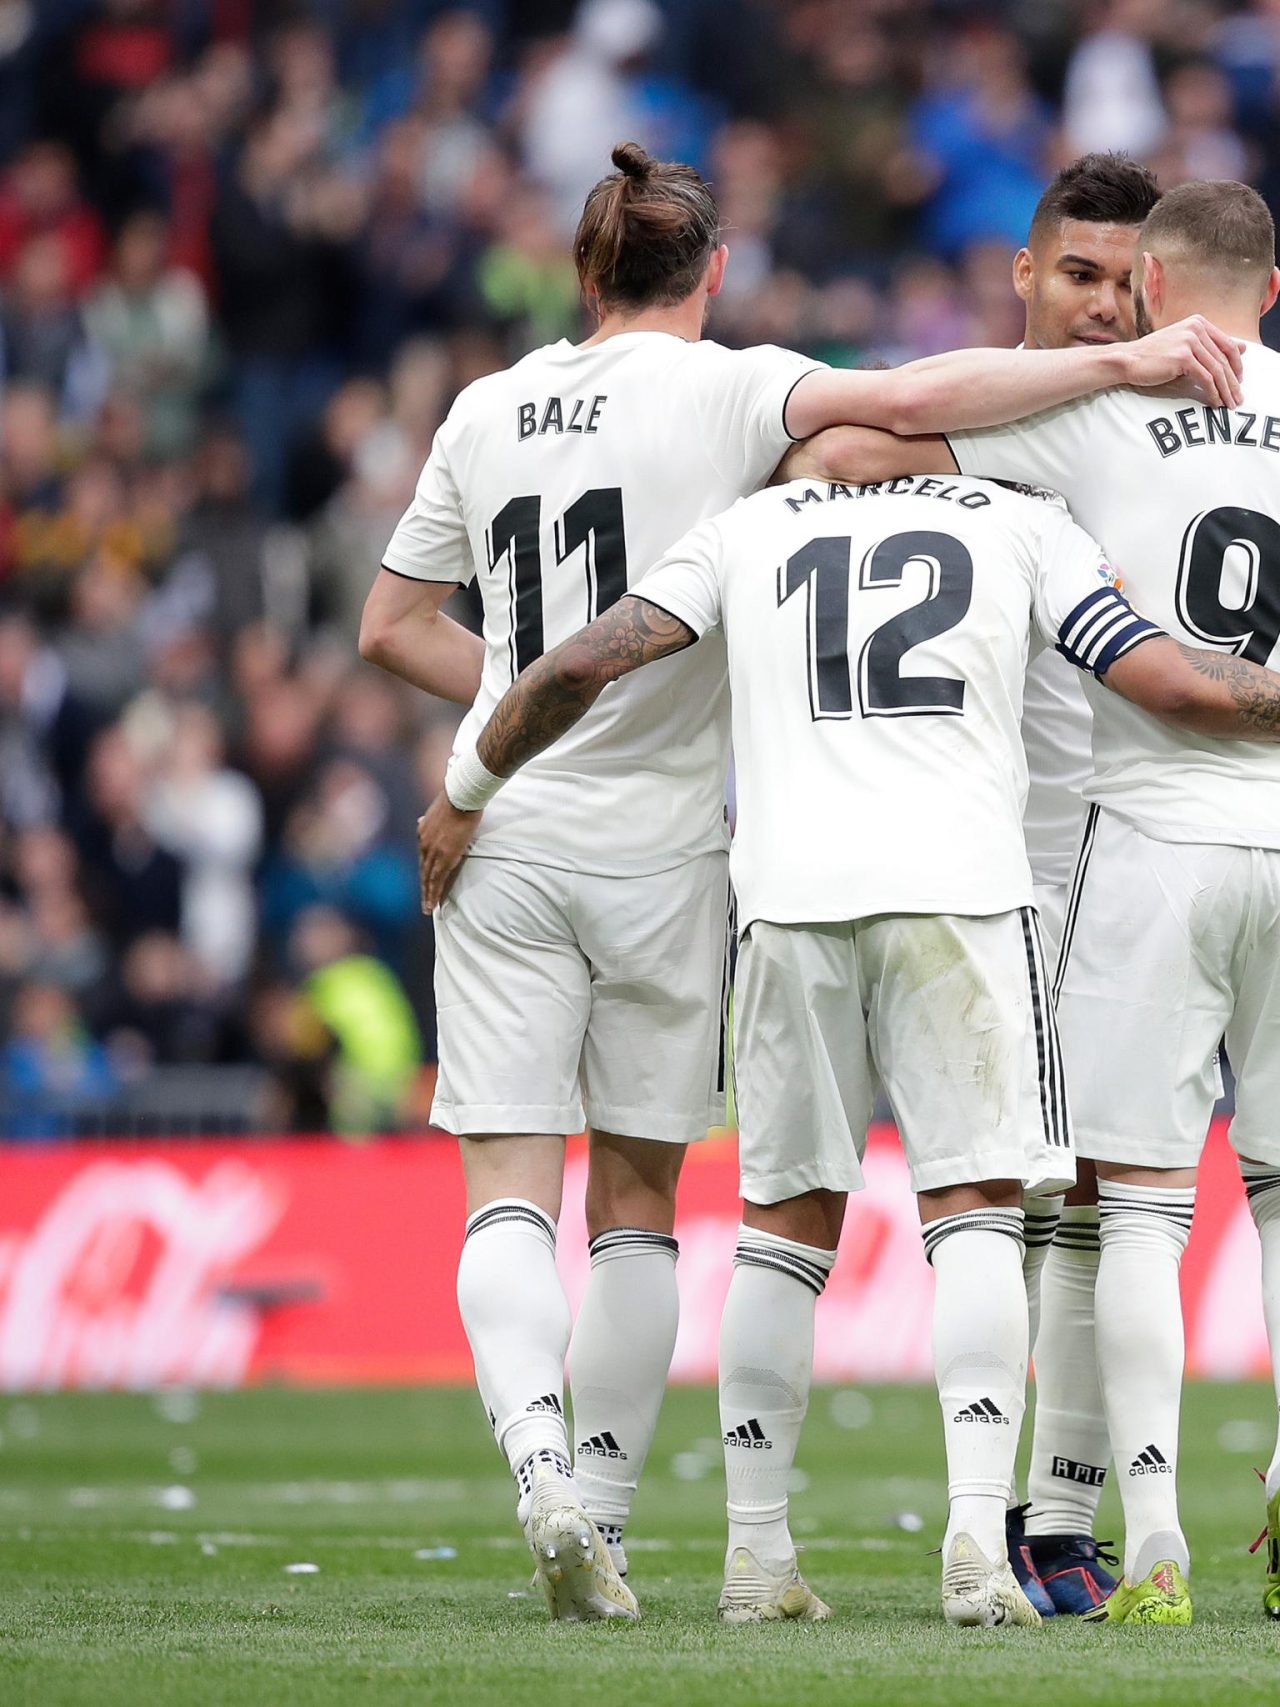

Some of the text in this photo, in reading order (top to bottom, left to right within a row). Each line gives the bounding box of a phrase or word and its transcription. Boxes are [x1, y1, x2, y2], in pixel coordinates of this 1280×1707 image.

[518, 395, 608, 442] BALE
[783, 476, 992, 515] MARCELO
[485, 487, 628, 682] 11
[777, 530, 974, 722] 12
[953, 1413, 1009, 1425] adidas
[577, 1446, 628, 1460] adidas
[723, 1436, 773, 1450] adidas
[1128, 1463, 1173, 1477] adidas
